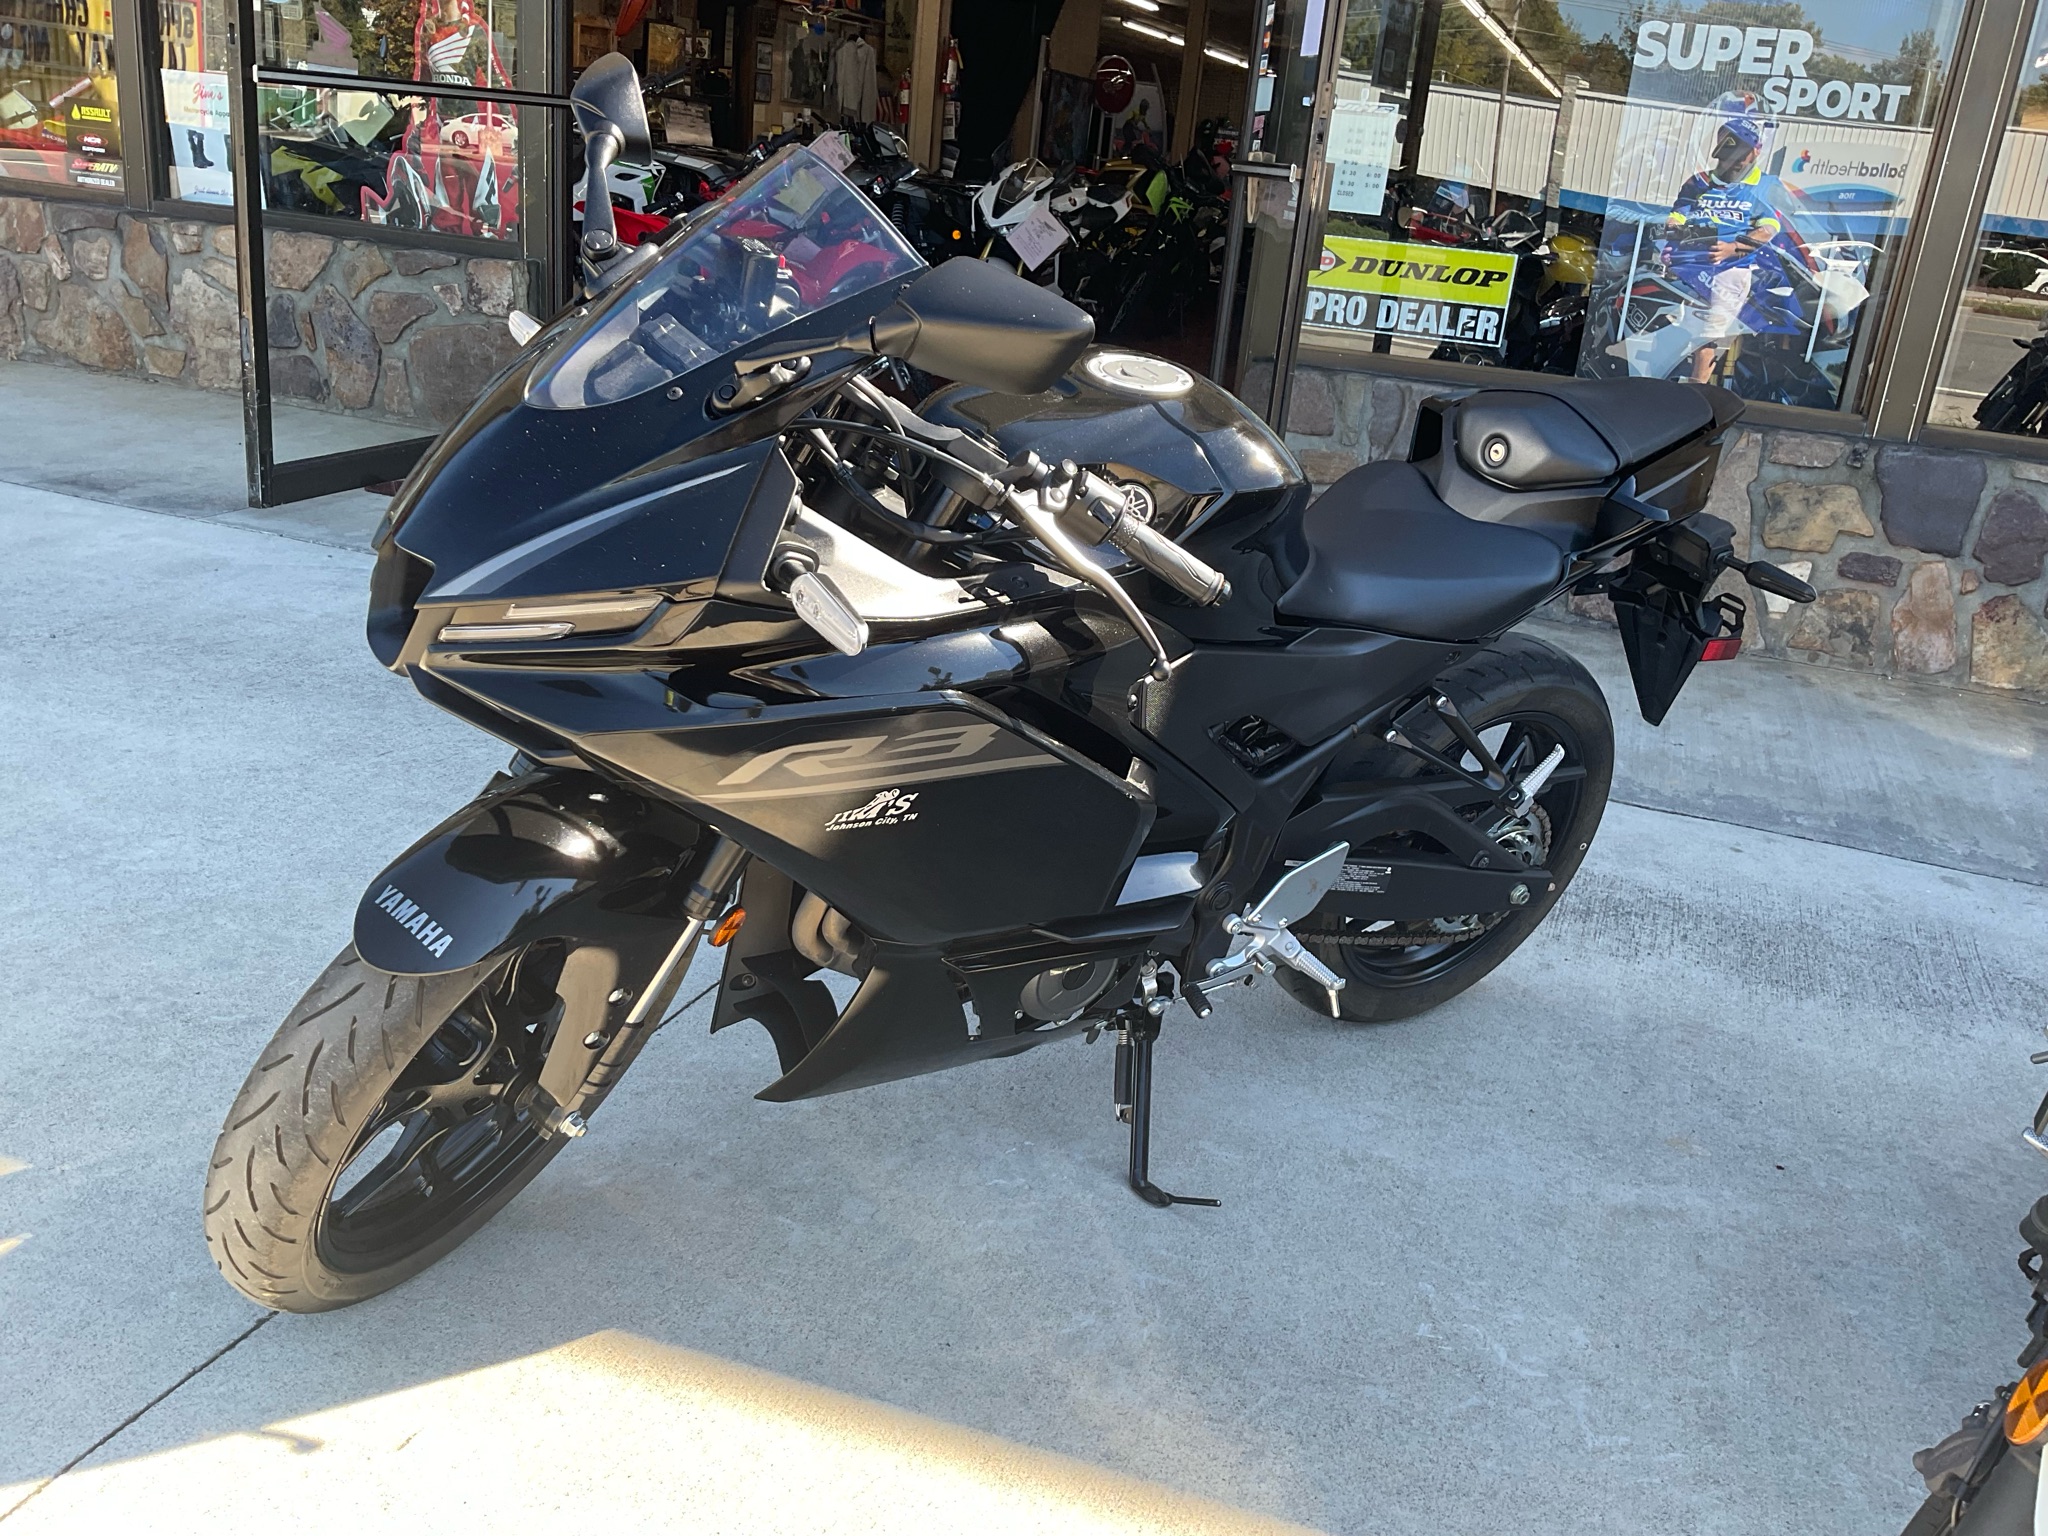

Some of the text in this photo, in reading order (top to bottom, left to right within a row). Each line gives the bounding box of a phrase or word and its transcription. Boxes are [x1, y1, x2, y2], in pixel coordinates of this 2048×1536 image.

[1633, 20, 1813, 77] SUPER
[432, 74, 472, 87] HONDA
[1763, 77, 1912, 122] SPORT
[1347, 256, 1508, 288] DUNLOP
[1304, 290, 1499, 342] PRO DEALER
[825, 813, 919, 832] Johnson City, TN
[374, 884, 454, 959] YAMAHA
